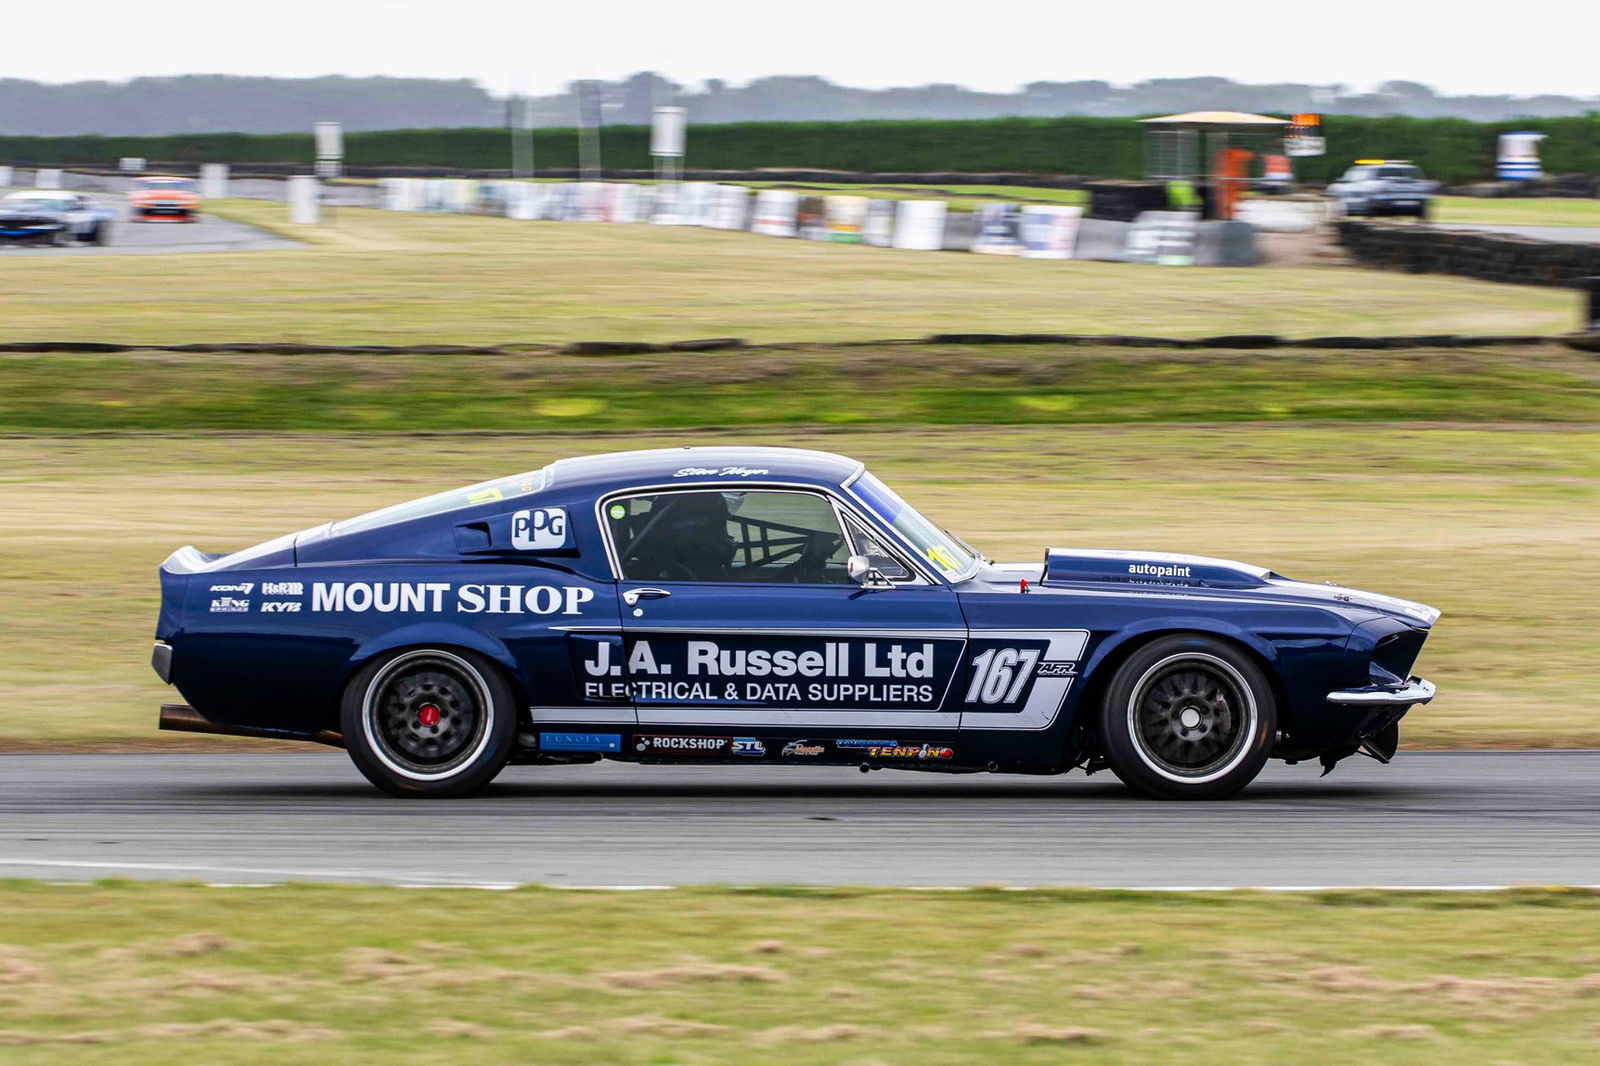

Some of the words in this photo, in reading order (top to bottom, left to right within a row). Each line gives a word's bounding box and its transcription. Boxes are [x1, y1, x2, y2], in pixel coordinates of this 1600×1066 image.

[513, 509, 564, 543] PPG
[1128, 563, 1191, 578] autopaint
[260, 601, 302, 613] KYB
[312, 582, 450, 612] MOUNT
[457, 584, 594, 614] SHOP
[687, 640, 849, 677] Russell
[864, 643, 934, 678] Ltd
[964, 648, 1041, 704] 167
[585, 682, 718, 699] ELECTRICAL
[724, 682, 739, 700] &
[746, 683, 802, 701] DATA
[808, 683, 933, 702] SUPPLIERS
[653, 737, 726, 750] ROCKSHOP
